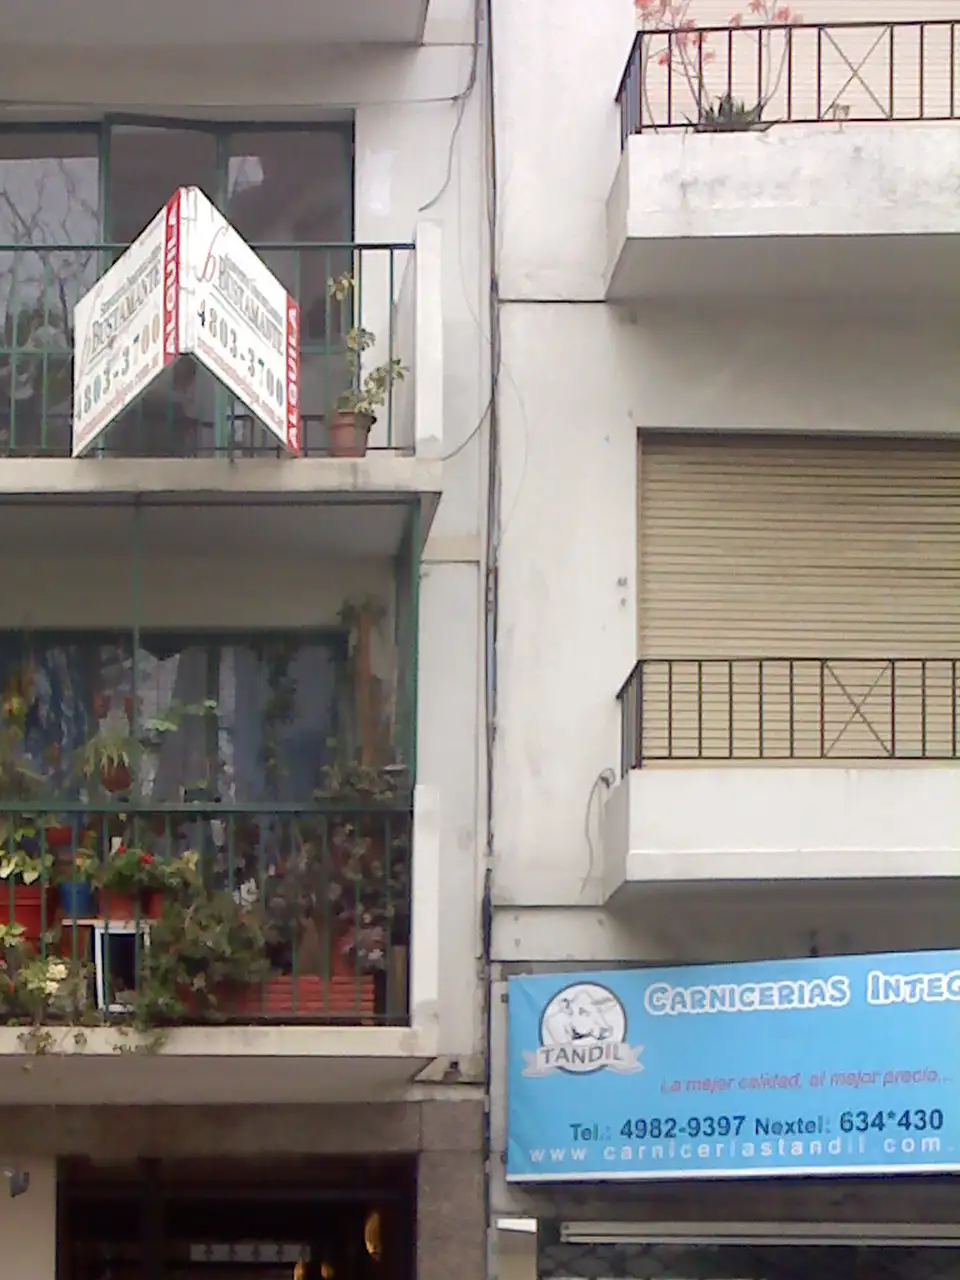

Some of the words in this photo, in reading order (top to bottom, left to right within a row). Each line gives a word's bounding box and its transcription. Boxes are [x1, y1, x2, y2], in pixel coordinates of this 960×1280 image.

[197, 298, 283, 408] 4803-3700
[644, 976, 850, 1015] CARNICERIAS
[541, 1044, 623, 1065] TANDIL
[620, 1115, 746, 1140] 4982-9397
[754, 1116, 831, 1136] Nextel:
